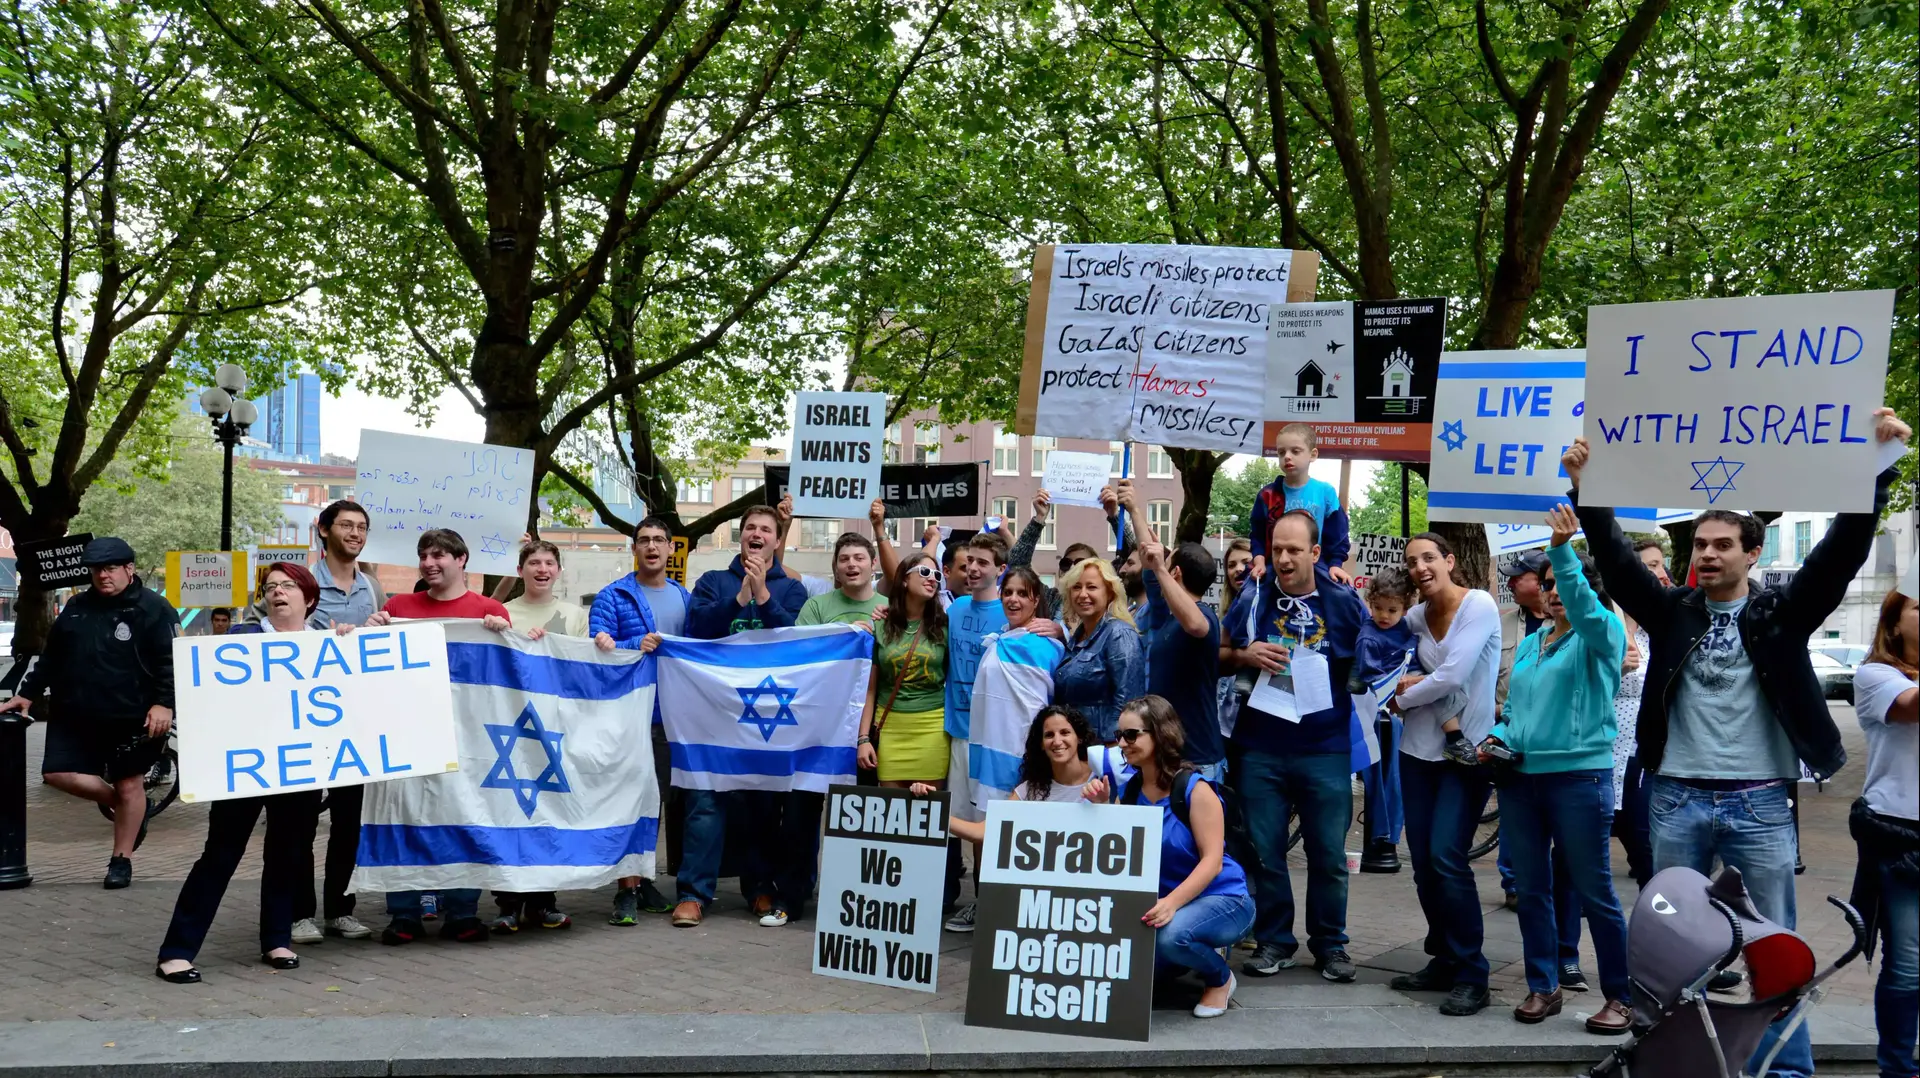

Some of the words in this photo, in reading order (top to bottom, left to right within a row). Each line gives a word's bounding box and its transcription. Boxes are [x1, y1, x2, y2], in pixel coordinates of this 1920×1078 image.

[1060, 249, 1134, 279] Israel's
[1140, 256, 1207, 284] missiles
[1212, 263, 1288, 288] protect
[1073, 283, 1162, 315] Israeli
[1364, 307, 1385, 316] HAMAS
[1386, 306, 1402, 315] USES
[1403, 305, 1434, 314] CIVILIANS
[1277, 320, 1285, 328] TO
[1286, 320, 1311, 328] PROTECT
[1278, 309, 1298, 318] ISRAEL
[1299, 309, 1314, 318] USES
[1315, 308, 1345, 317] WEAPONS
[1364, 318, 1372, 326] TO
[1373, 317, 1400, 326] PROTECT
[1401, 316, 1411, 325] ITS
[1276, 330, 1307, 338] CIVILIANS.
[1363, 328, 1394, 337] WEAPONS.
[1624, 335, 1645, 376] I
[1689, 326, 1864, 372] STAND
[1041, 365, 1123, 395] protect
[1477, 386, 1552, 418] LIVE
[806, 404, 871, 427] ISRAEL
[1139, 400, 1255, 447] missiles!
[1598, 413, 1698, 444] WITH
[1720, 404, 1867, 445] ISRAEL
[1315, 425, 1331, 434] PUTS
[1332, 425, 1373, 435] PALESTINIAN
[1374, 426, 1406, 436] CIVILIANS
[1316, 436, 1323, 445] IN
[1324, 437, 1336, 445] THE
[1337, 437, 1351, 446] LINE
[1353, 438, 1362, 446] OF
[1363, 438, 1380, 447] FIRE.
[801, 440, 870, 464] WANTS
[1474, 443, 1543, 476] LET
[799, 476, 867, 500] PEACE!
[907, 482, 969, 500] LIVES
[450, 510, 484, 521] never
[36, 549, 54, 560] THE
[55, 544, 84, 556] RIGHT
[1360, 533, 1387, 549] IT'S
[1390, 537, 1406, 550] NO
[40, 561, 54, 570] TO
[56, 560, 64, 568] A
[65, 556, 82, 567] SAF
[195, 554, 217, 564] End
[258, 553, 306, 561] BOYCOTT
[1356, 548, 1363, 562] A
[1366, 549, 1403, 563] CONFLI
[40, 567, 89, 582] CHILDHOO
[186, 567, 226, 578] Israeli
[181, 581, 232, 591] Apartheid
[191, 631, 431, 687] ISRAEL
[291, 685, 344, 730] IS
[226, 734, 412, 793] REAL
[829, 793, 945, 839] ISRAEL
[997, 820, 1146, 877] Israel
[860, 848, 902, 887] We
[840, 890, 917, 935] Stand
[1017, 889, 1114, 935] Must
[818, 931, 877, 976] With
[884, 941, 933, 984] You
[992, 929, 1132, 980] Defend
[1006, 974, 1111, 1024] Itself
